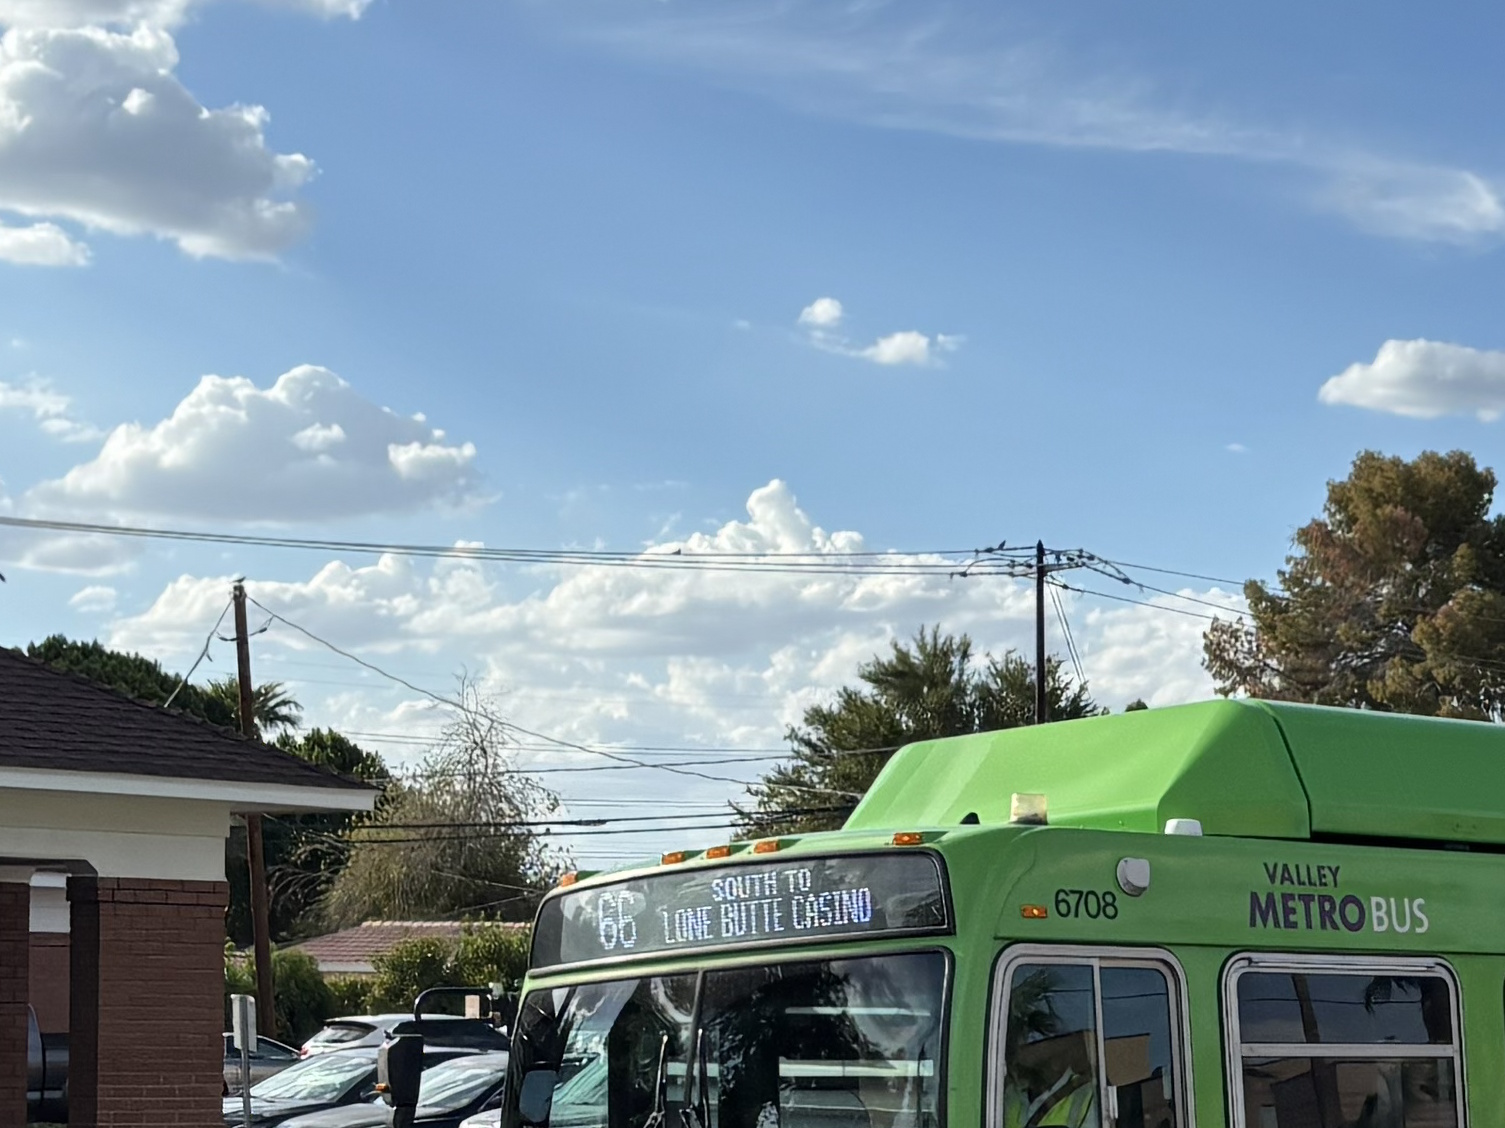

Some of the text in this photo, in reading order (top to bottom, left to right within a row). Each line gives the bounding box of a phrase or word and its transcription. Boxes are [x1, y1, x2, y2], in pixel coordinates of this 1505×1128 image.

[712, 869, 811, 902] SOUTH TO
[1263, 862, 1341, 888] VALLEY
[598, 890, 637, 950] 66
[662, 887, 873, 944] LONE BUTTE CASINO
[1054, 888, 1118, 920] 6708
